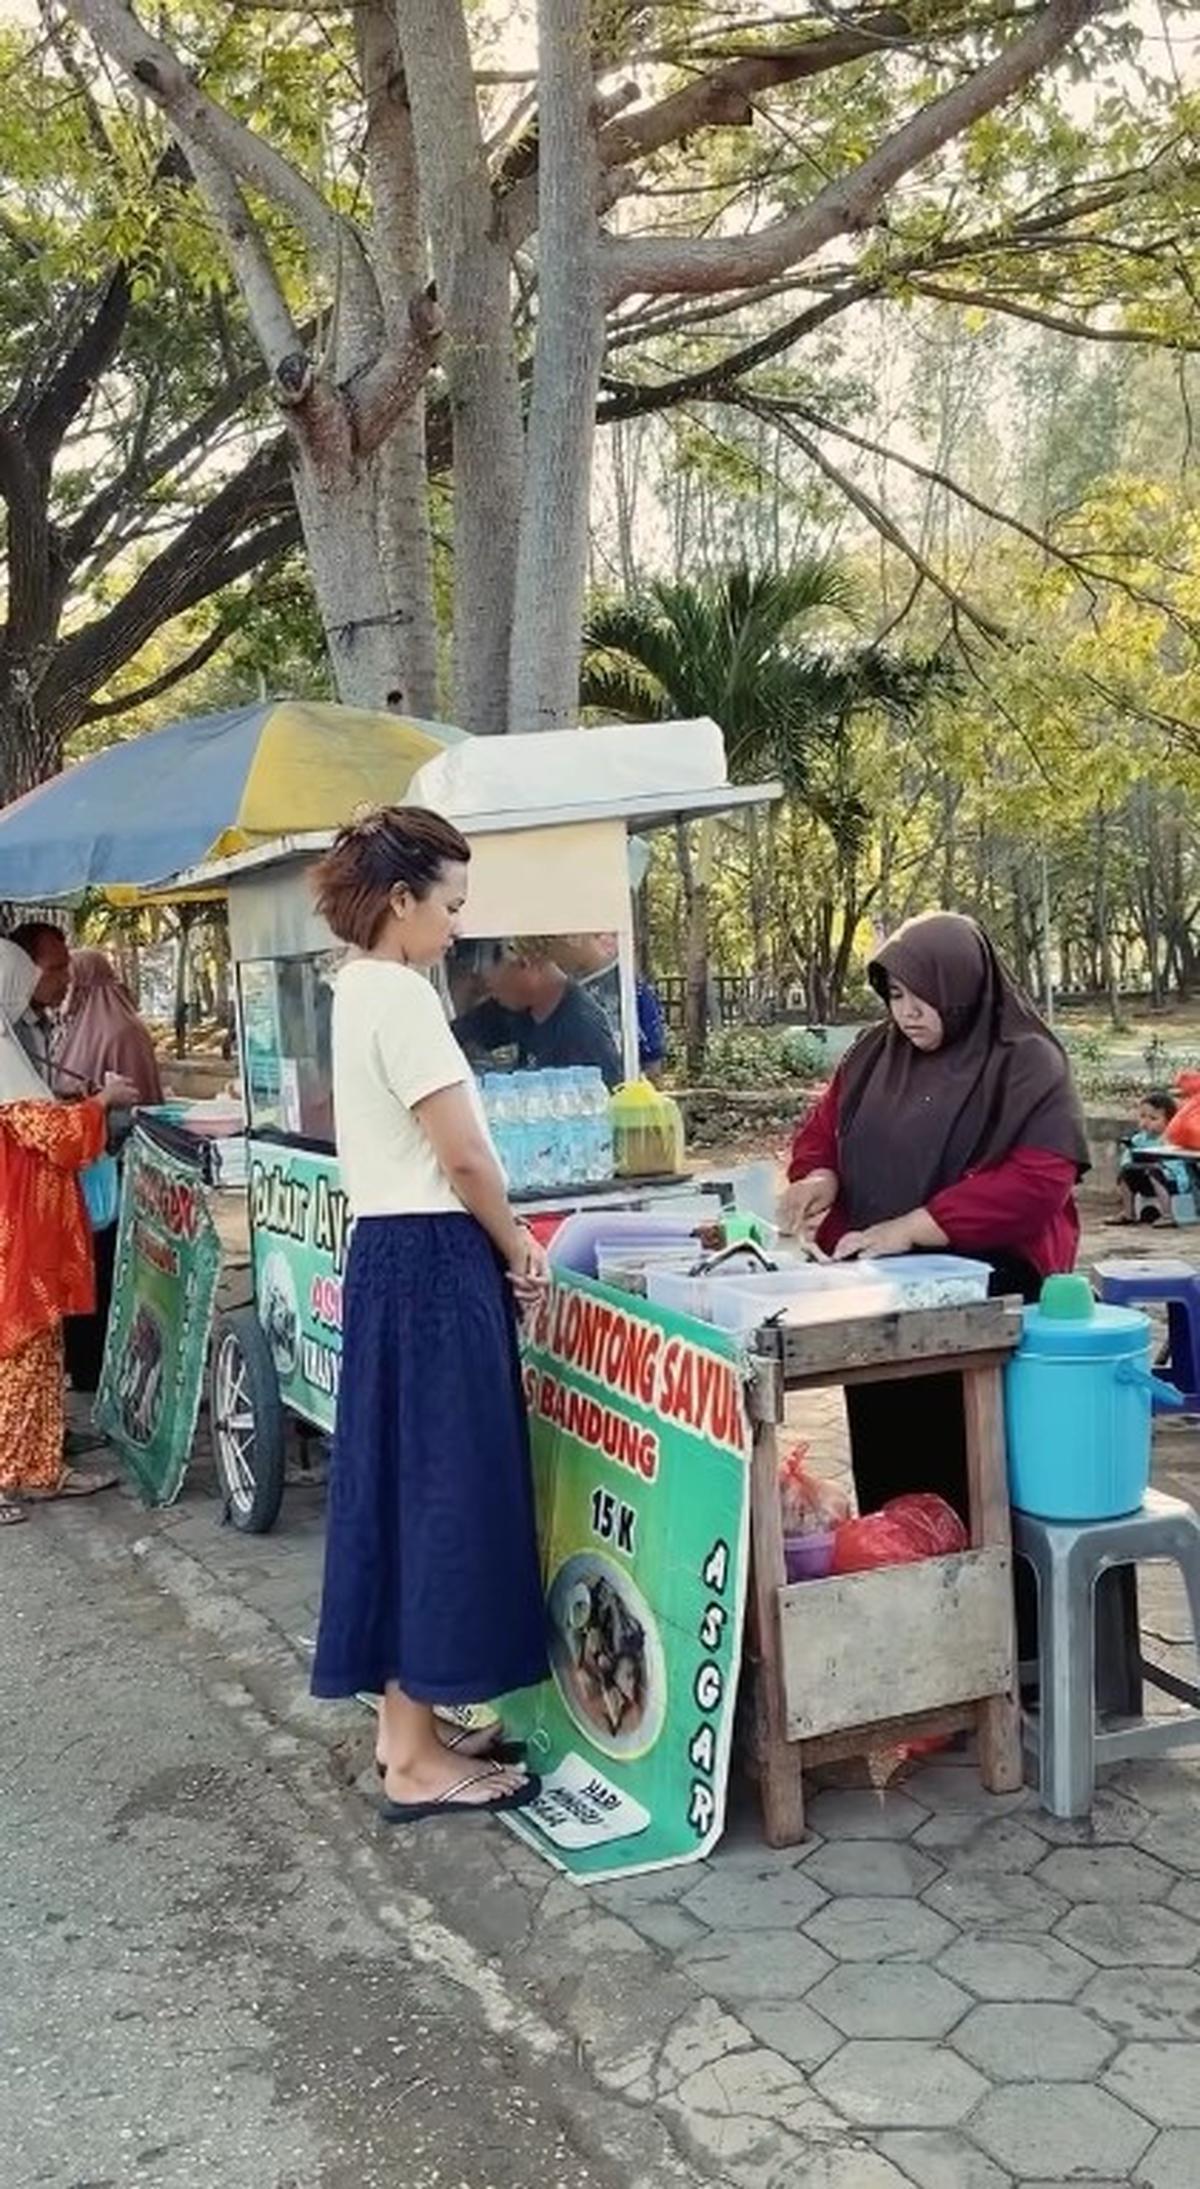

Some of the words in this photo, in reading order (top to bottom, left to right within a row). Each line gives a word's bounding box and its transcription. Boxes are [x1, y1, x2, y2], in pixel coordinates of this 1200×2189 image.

[314, 1173, 350, 1276] Ay
[550, 1284, 661, 1408] LONTONG
[539, 1374, 659, 1480] BANDUNG
[590, 1486, 615, 1541] 15
[616, 1502, 636, 1557] K
[687, 1537, 729, 1838] ASGAR
